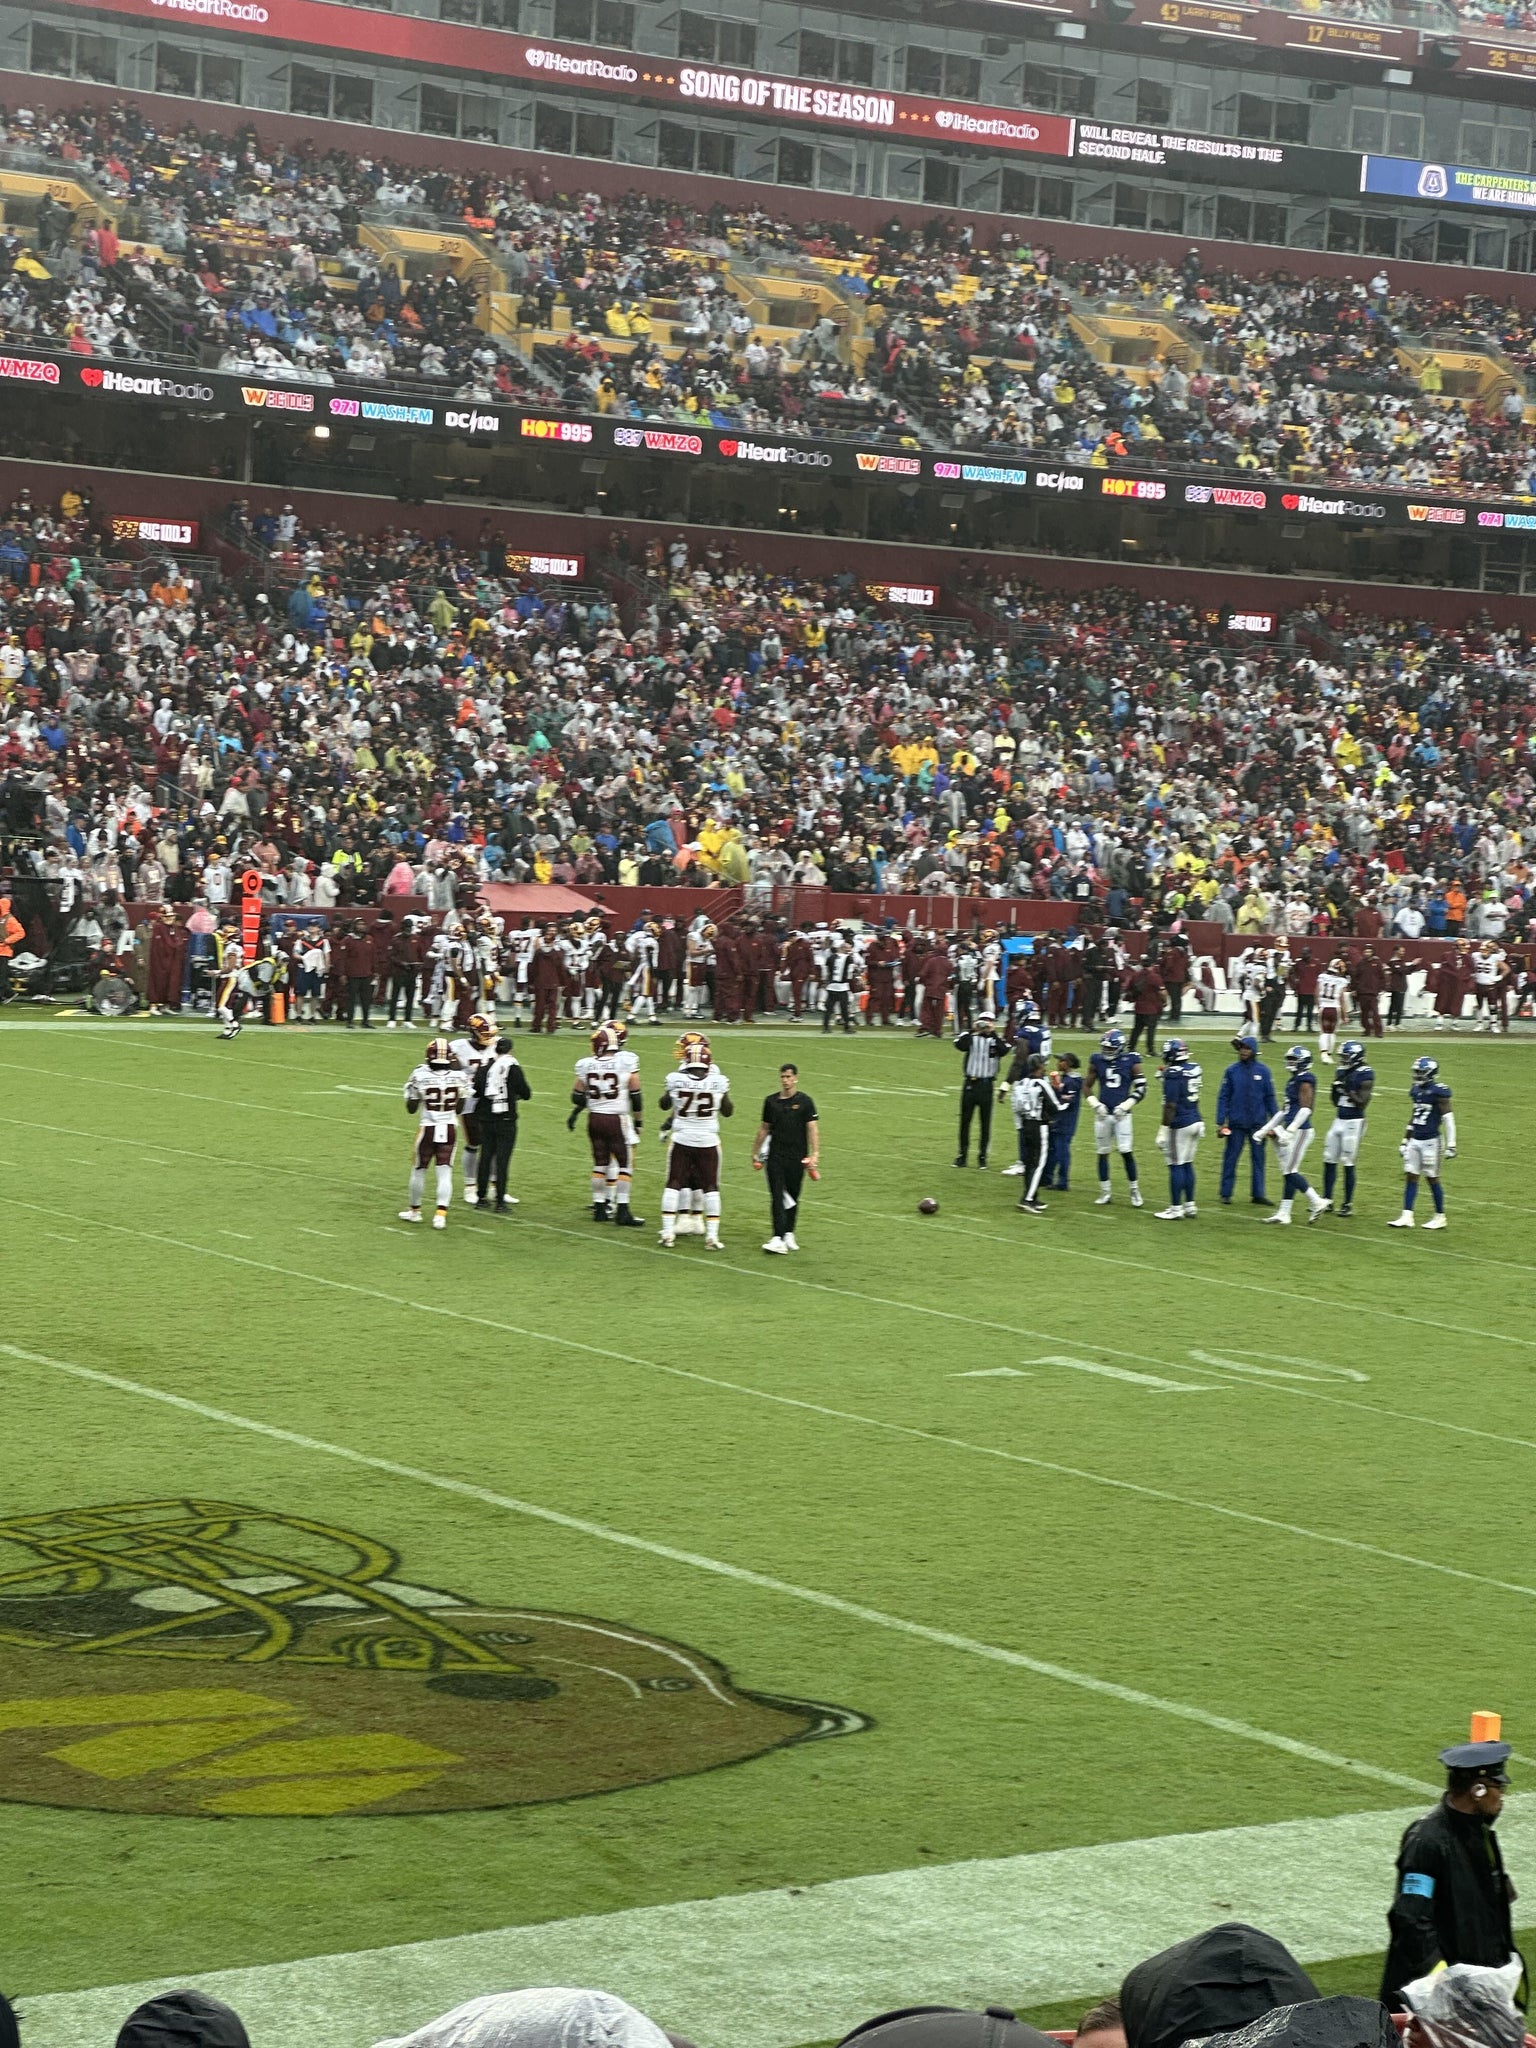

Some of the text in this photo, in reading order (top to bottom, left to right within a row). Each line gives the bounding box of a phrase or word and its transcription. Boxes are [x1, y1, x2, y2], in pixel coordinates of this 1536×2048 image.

[543, 51, 637, 82] iHeartRadio
[680, 68, 895, 126] SONG OF THE SEASON
[952, 112, 1039, 140] iHeartRadio
[1078, 141, 1131, 160] SECOND
[1111, 129, 1160, 147] REVEAL
[1161, 135, 1186, 149] THE
[1187, 140, 1241, 158] RESULTS
[1257, 147, 1283, 162] THE
[1455, 171, 1474, 186] THE
[1474, 174, 1530, 193] CARPENTERS
[1472, 186, 1488, 200] WE
[1488, 188, 1507, 203] ARE
[103, 370, 214, 401] iHeartRadio
[521, 419, 559, 438] HOT
[644, 431, 702, 454] WMZQ
[738, 441, 832, 466] iHeartRadio
[1102, 478, 1137, 496] HOT
[1212, 487, 1266, 509] WMZQ
[1298, 496, 1386, 518] iHeartRadio
[1105, 1066, 1122, 1088] 5
[426, 1087, 459, 1112] 22
[678, 1090, 713, 1117] 72
